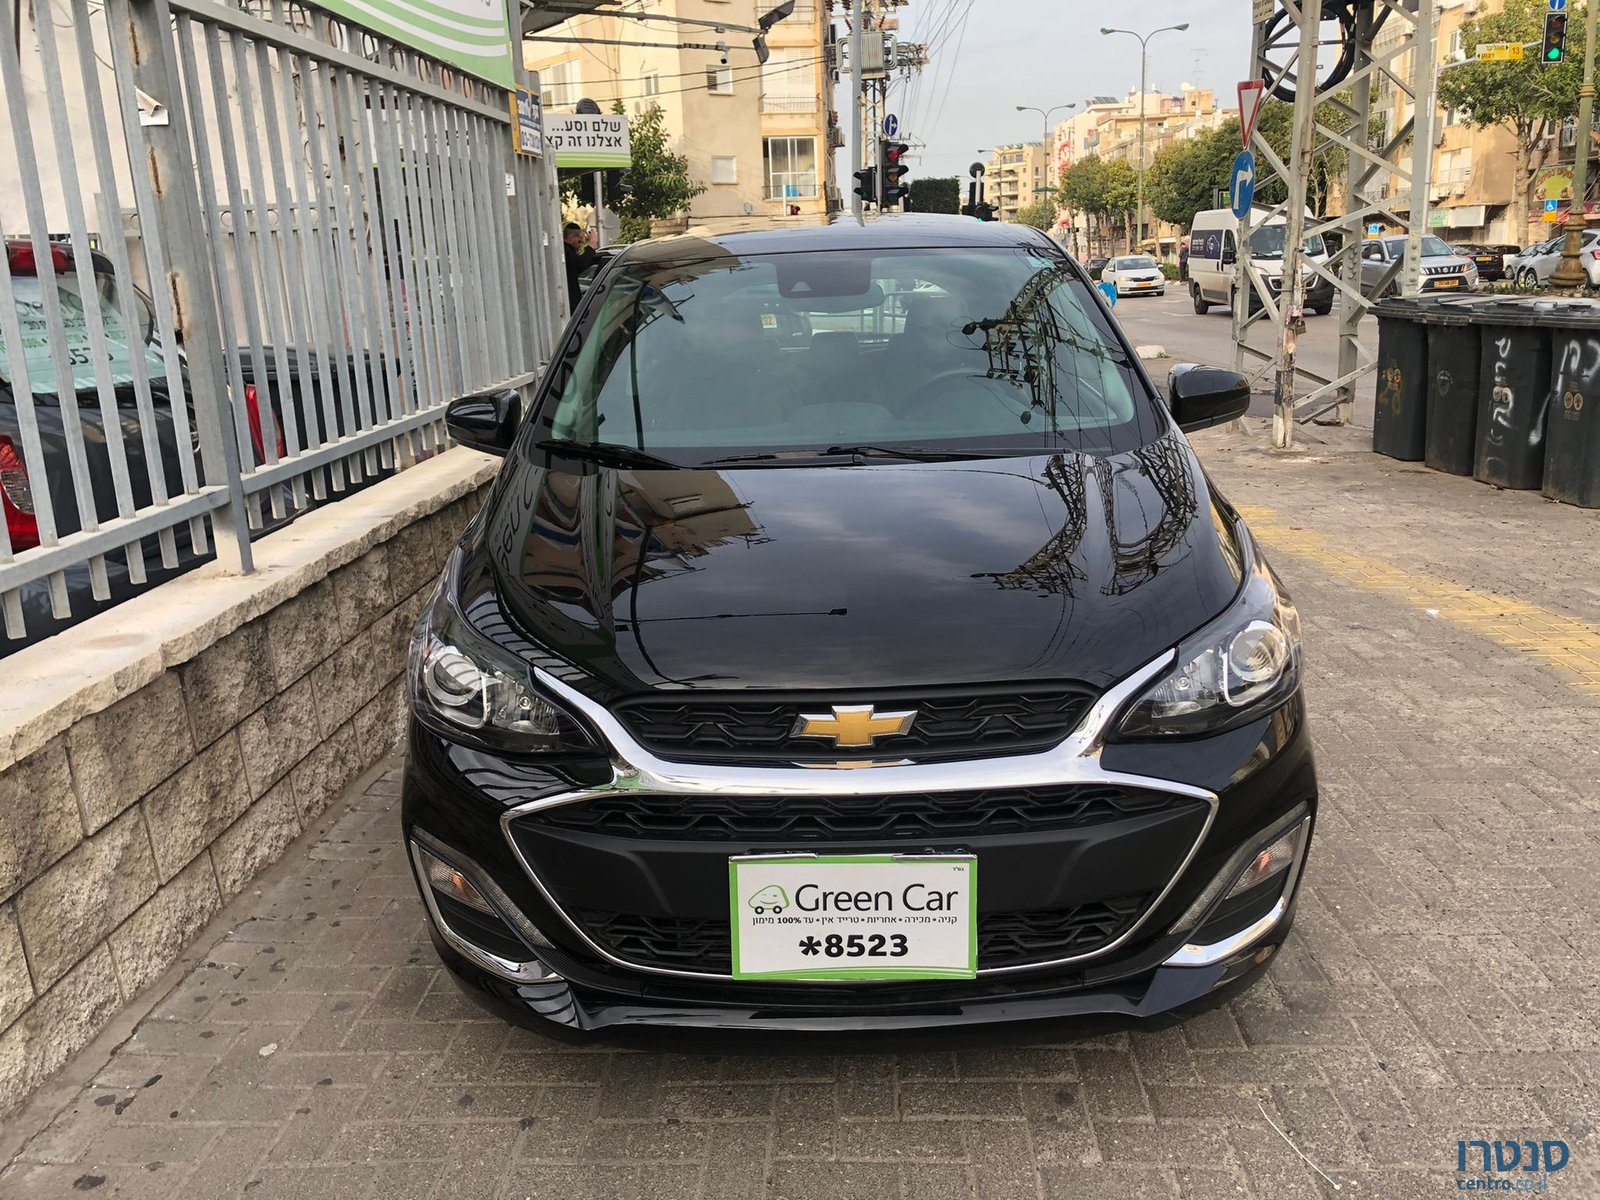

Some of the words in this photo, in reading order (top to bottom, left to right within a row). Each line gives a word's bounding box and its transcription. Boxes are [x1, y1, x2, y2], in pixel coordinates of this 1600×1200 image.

[1511, 46, 1520, 55] 13
[552, 120, 588, 132] וסע...
[592, 118, 621, 132] שלם
[568, 136, 582, 147] זה
[587, 133, 622, 147] אצלנו
[795, 883, 893, 912] Green
[902, 883, 958, 911] Car
[752, 916, 775, 926] מימון
[777, 916, 802, 924] 100%
[803, 916, 814, 924] עד
[821, 916, 834, 925] אין
[836, 916, 860, 924] טרייד
[866, 916, 897, 924] אחריות
[904, 916, 931, 924] מכירה
[938, 916, 958, 925] קניה
